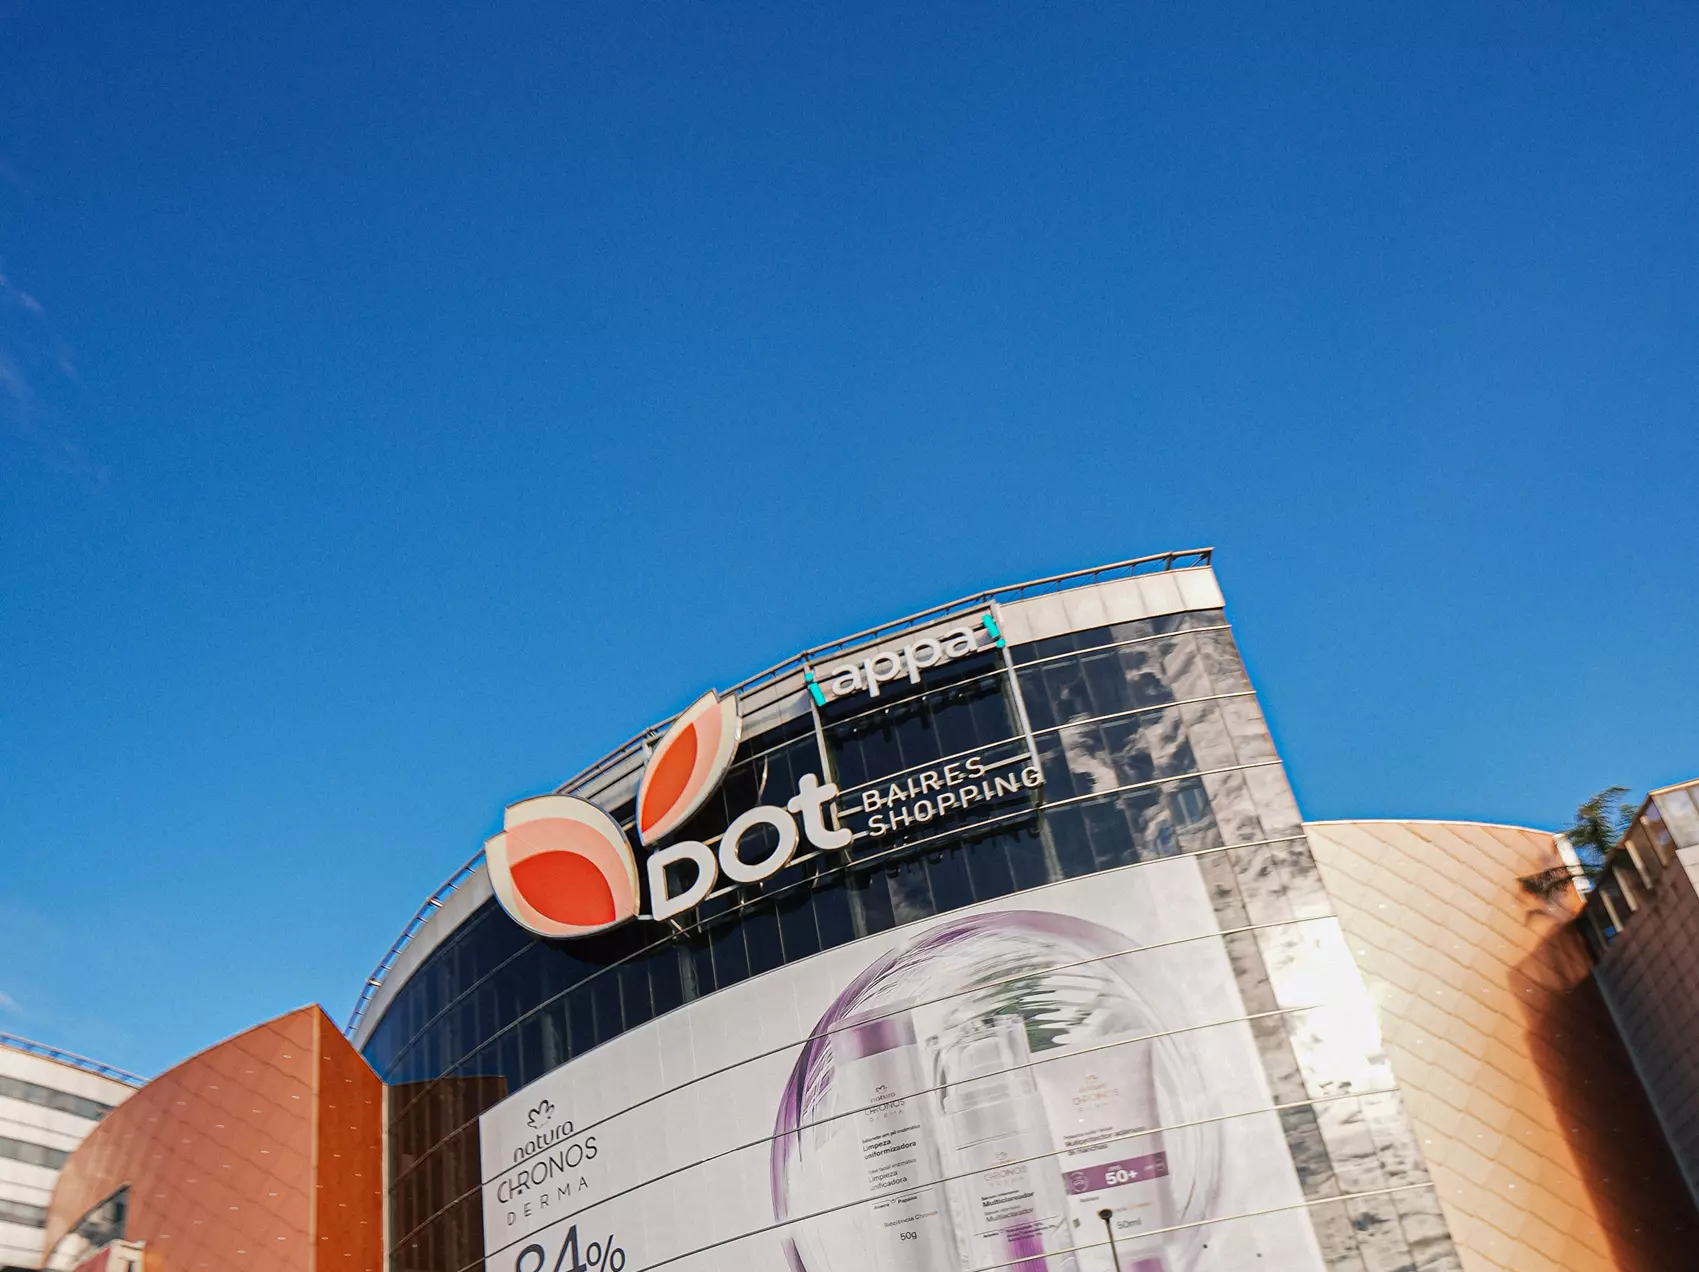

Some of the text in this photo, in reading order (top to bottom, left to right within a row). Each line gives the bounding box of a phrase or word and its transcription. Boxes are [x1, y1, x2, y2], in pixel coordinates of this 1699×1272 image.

[862, 756, 985, 812] BAIRES
[867, 766, 1042, 837] SHOPPING
[513, 1121, 574, 1162] natura
[497, 1136, 598, 1204] CHRONOS
[1105, 1169, 1138, 1185] 50+
[506, 1176, 588, 1226] DERMA
[900, 1231, 917, 1241] 50g
